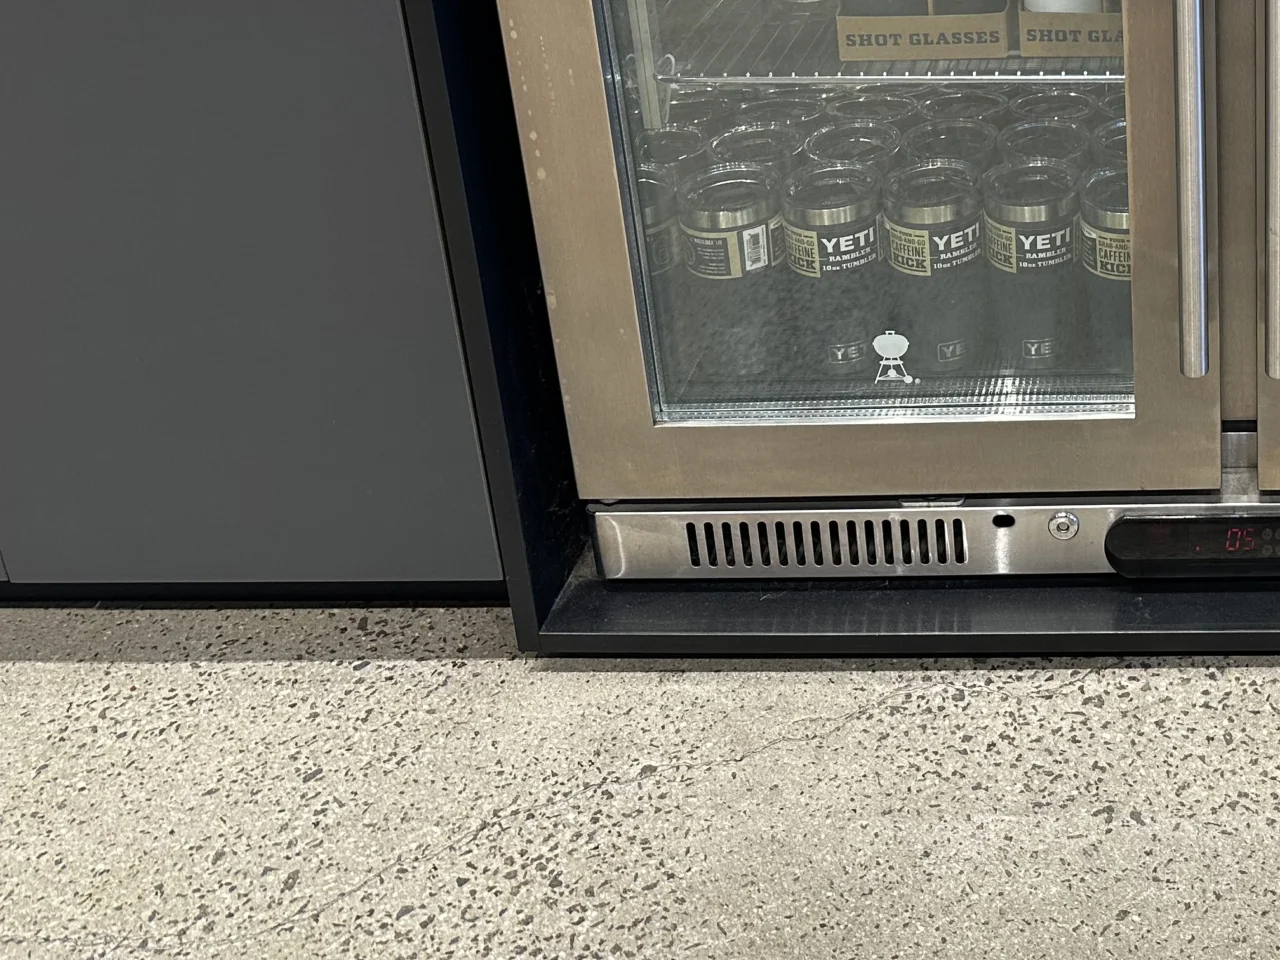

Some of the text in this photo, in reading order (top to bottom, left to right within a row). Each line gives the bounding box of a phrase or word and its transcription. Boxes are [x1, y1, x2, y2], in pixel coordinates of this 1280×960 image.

[845, 30, 1001, 47] SHOT GLASSES
[1026, 28, 1081, 43] SHOT
[820, 226, 874, 253] YETI
[932, 222, 980, 251] YETI
[1018, 227, 1071, 250] YETI
[829, 246, 871, 262] RAMBLER
[892, 240, 926, 258] CAFFEINE
[940, 242, 977, 260] RAMBLER
[952, 247, 981, 266] TUMBLER
[1026, 247, 1067, 259] RAMBLER
[842, 253, 876, 269] TUMBLER
[893, 251, 927, 269] KICK
[1037, 253, 1072, 267] TUMBLER
[1225, 528, 1255, 551] 05
